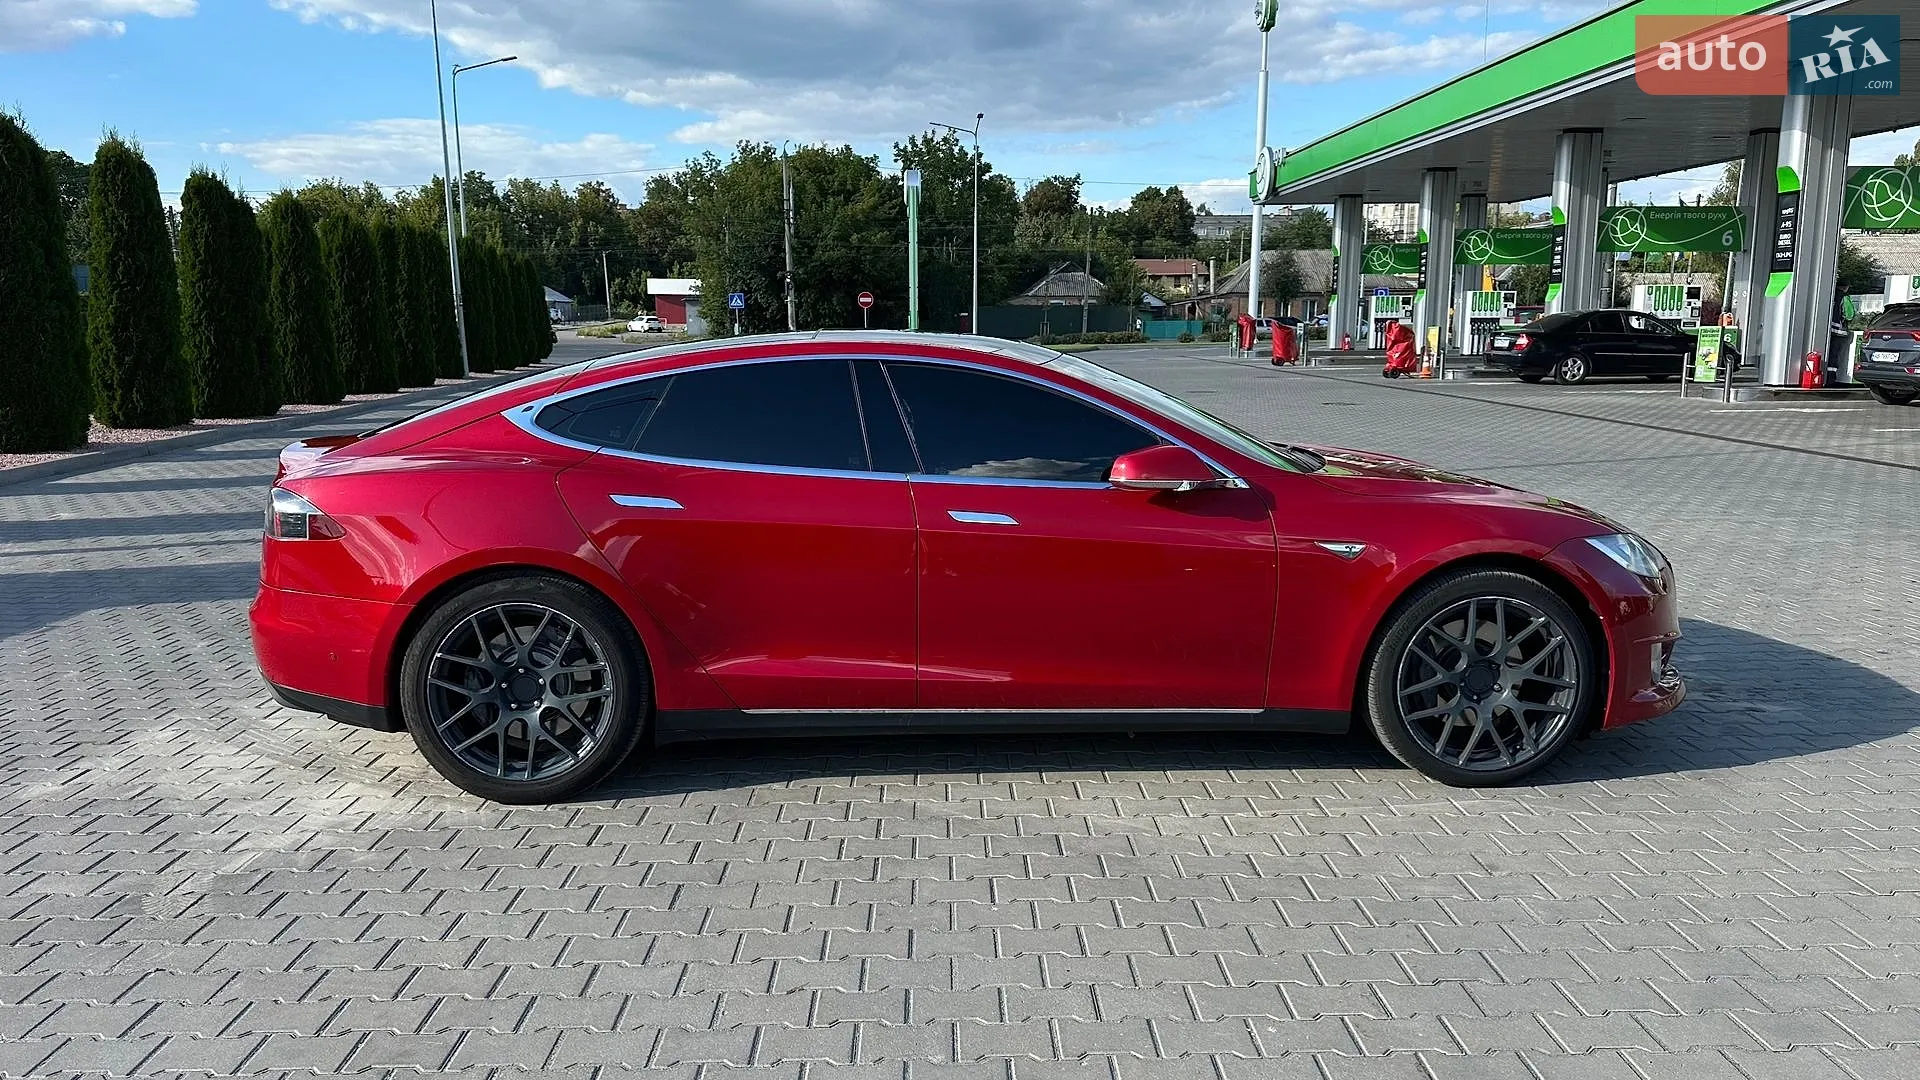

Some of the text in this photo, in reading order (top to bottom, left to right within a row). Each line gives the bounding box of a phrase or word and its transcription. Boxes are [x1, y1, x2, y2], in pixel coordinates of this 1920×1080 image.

[1649, 211, 1728, 220] Енергія твого руху
[1721, 229, 1734, 247] 6
[1723, 333, 1732, 343] 6
